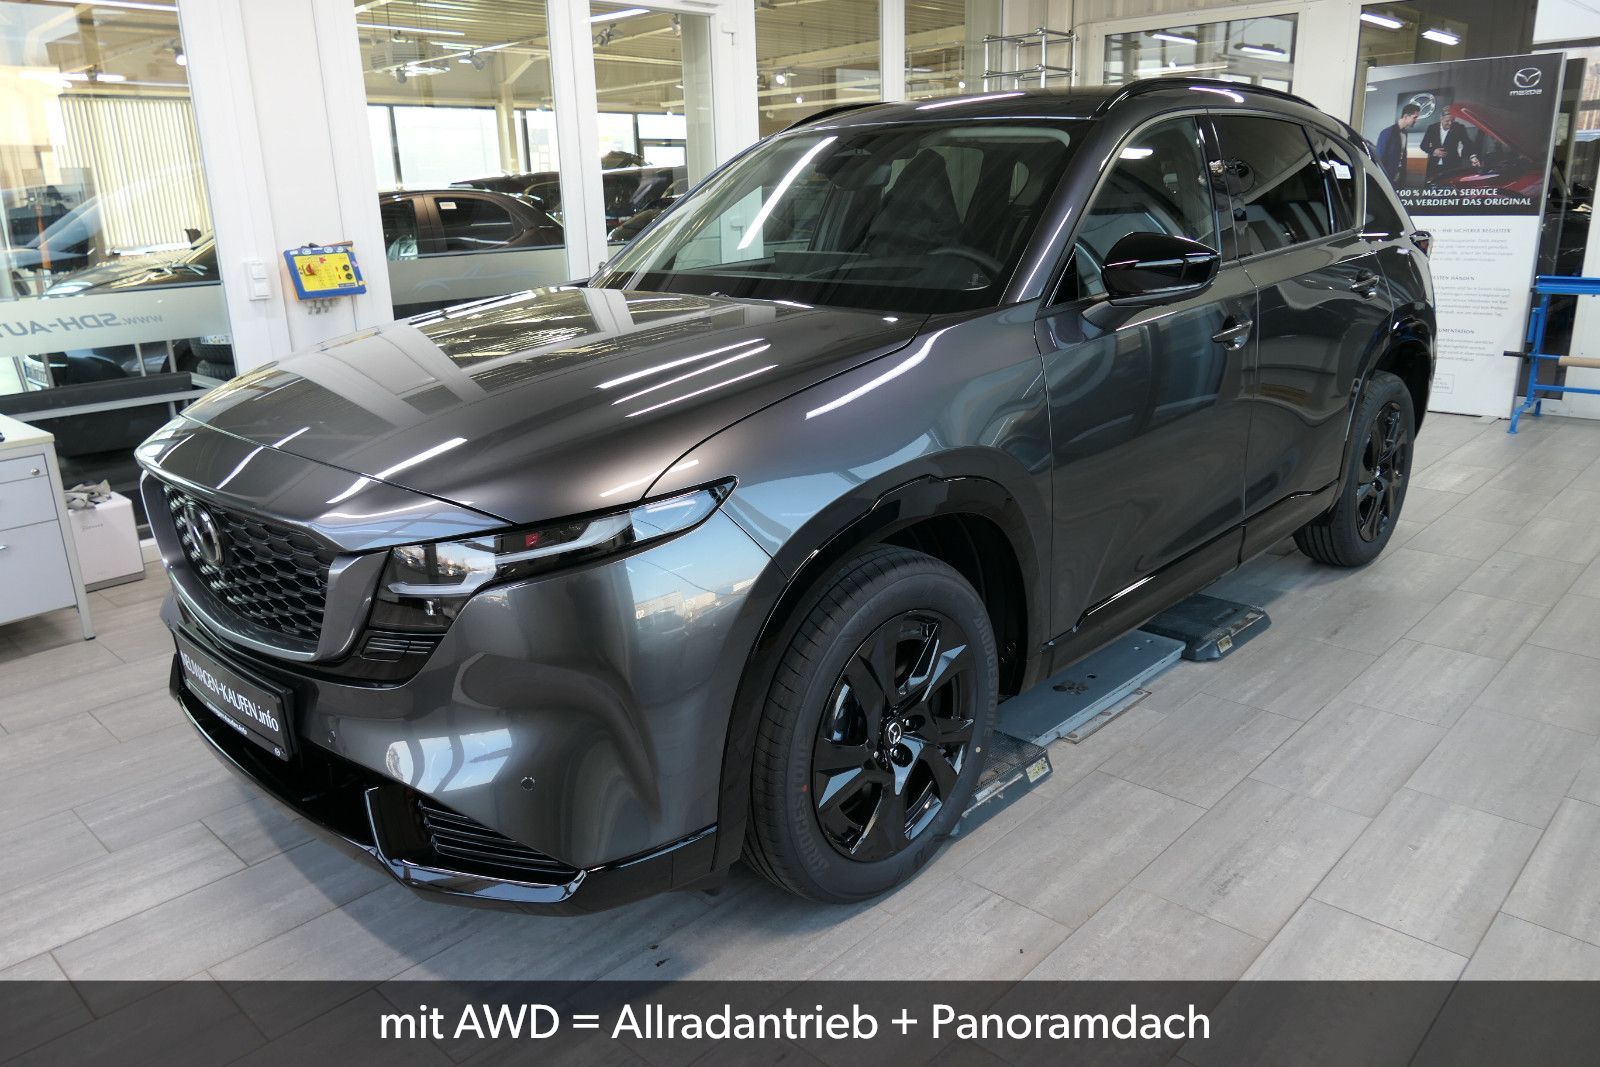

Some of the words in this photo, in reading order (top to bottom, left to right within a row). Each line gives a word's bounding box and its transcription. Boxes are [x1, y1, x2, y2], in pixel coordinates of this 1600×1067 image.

[1460, 188, 1498, 196] SERVICE
[1415, 198, 1460, 206] VERDIENT
[1462, 198, 1481, 206] DAS
[1484, 198, 1532, 206] ORIGINAL
